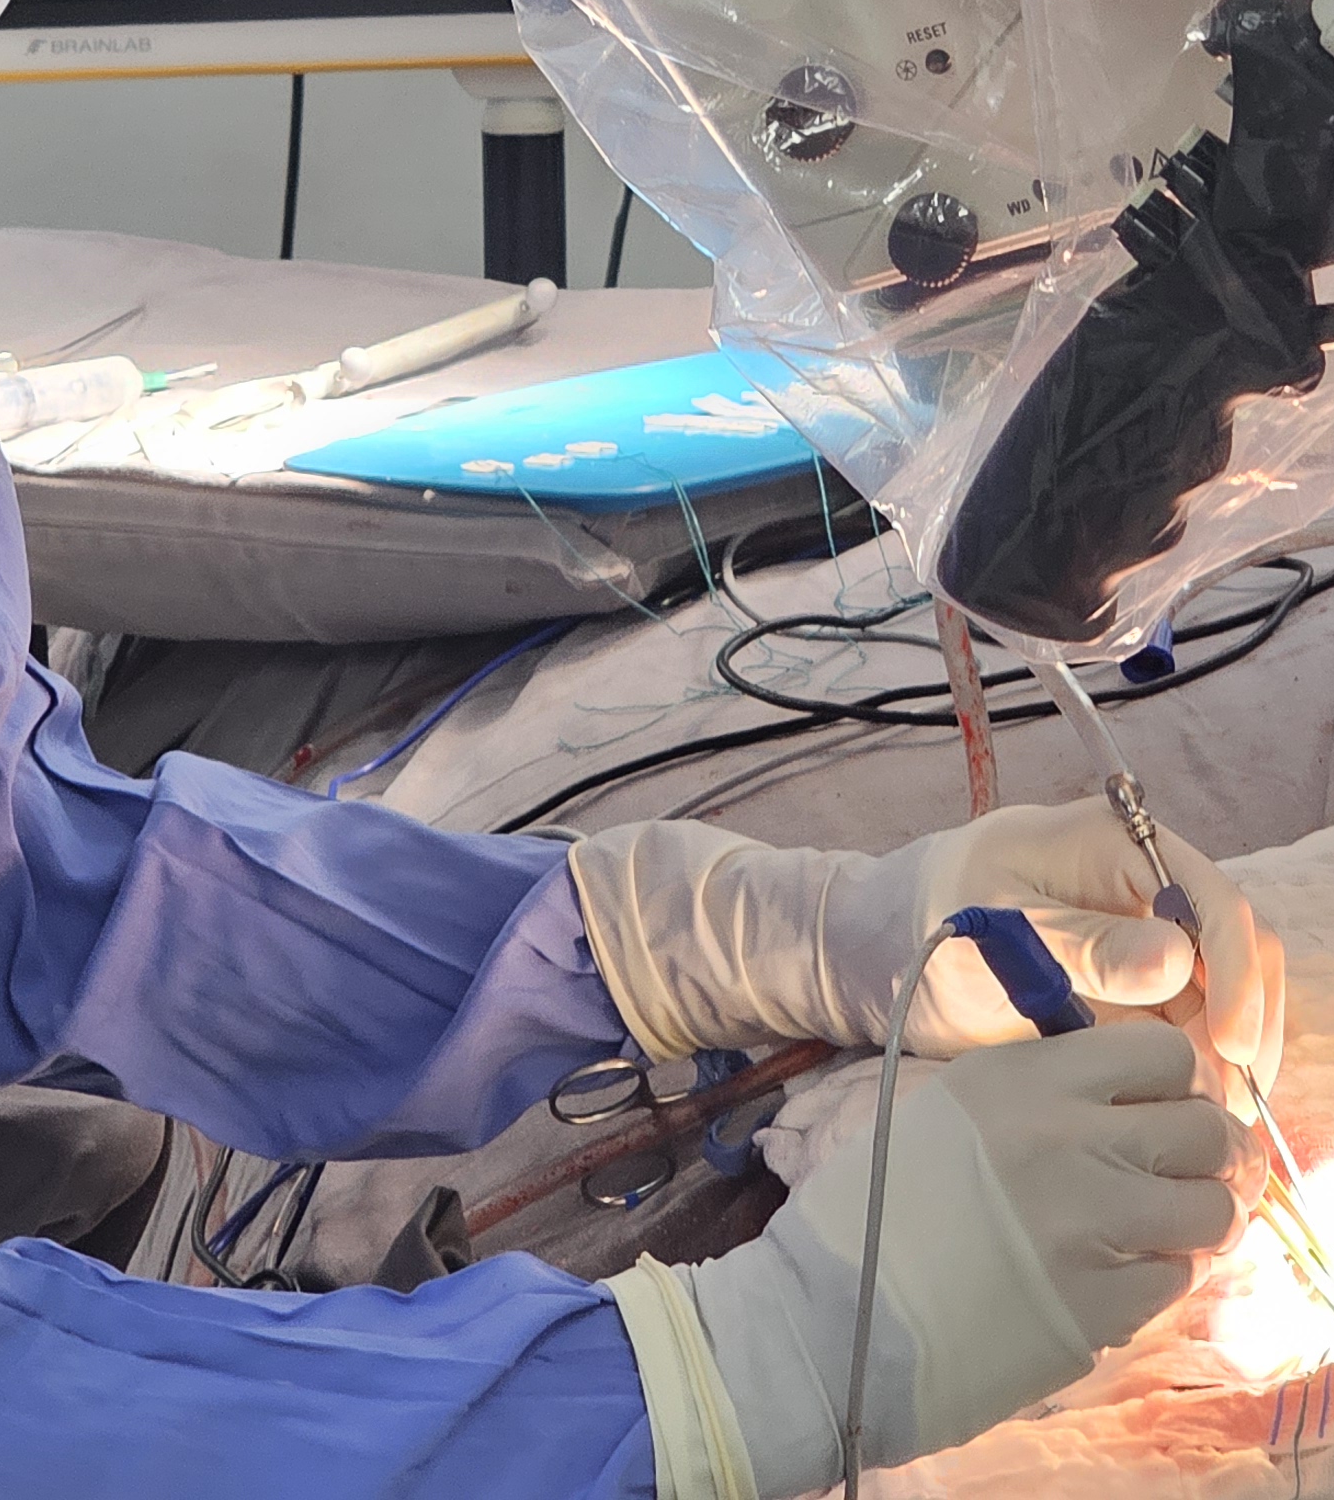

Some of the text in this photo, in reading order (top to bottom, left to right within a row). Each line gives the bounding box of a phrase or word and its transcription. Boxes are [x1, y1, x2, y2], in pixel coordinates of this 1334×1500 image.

[906, 21, 948, 44] RESET
[51, 36, 153, 54] BRAINLAB
[1007, 199, 1031, 216] WD
